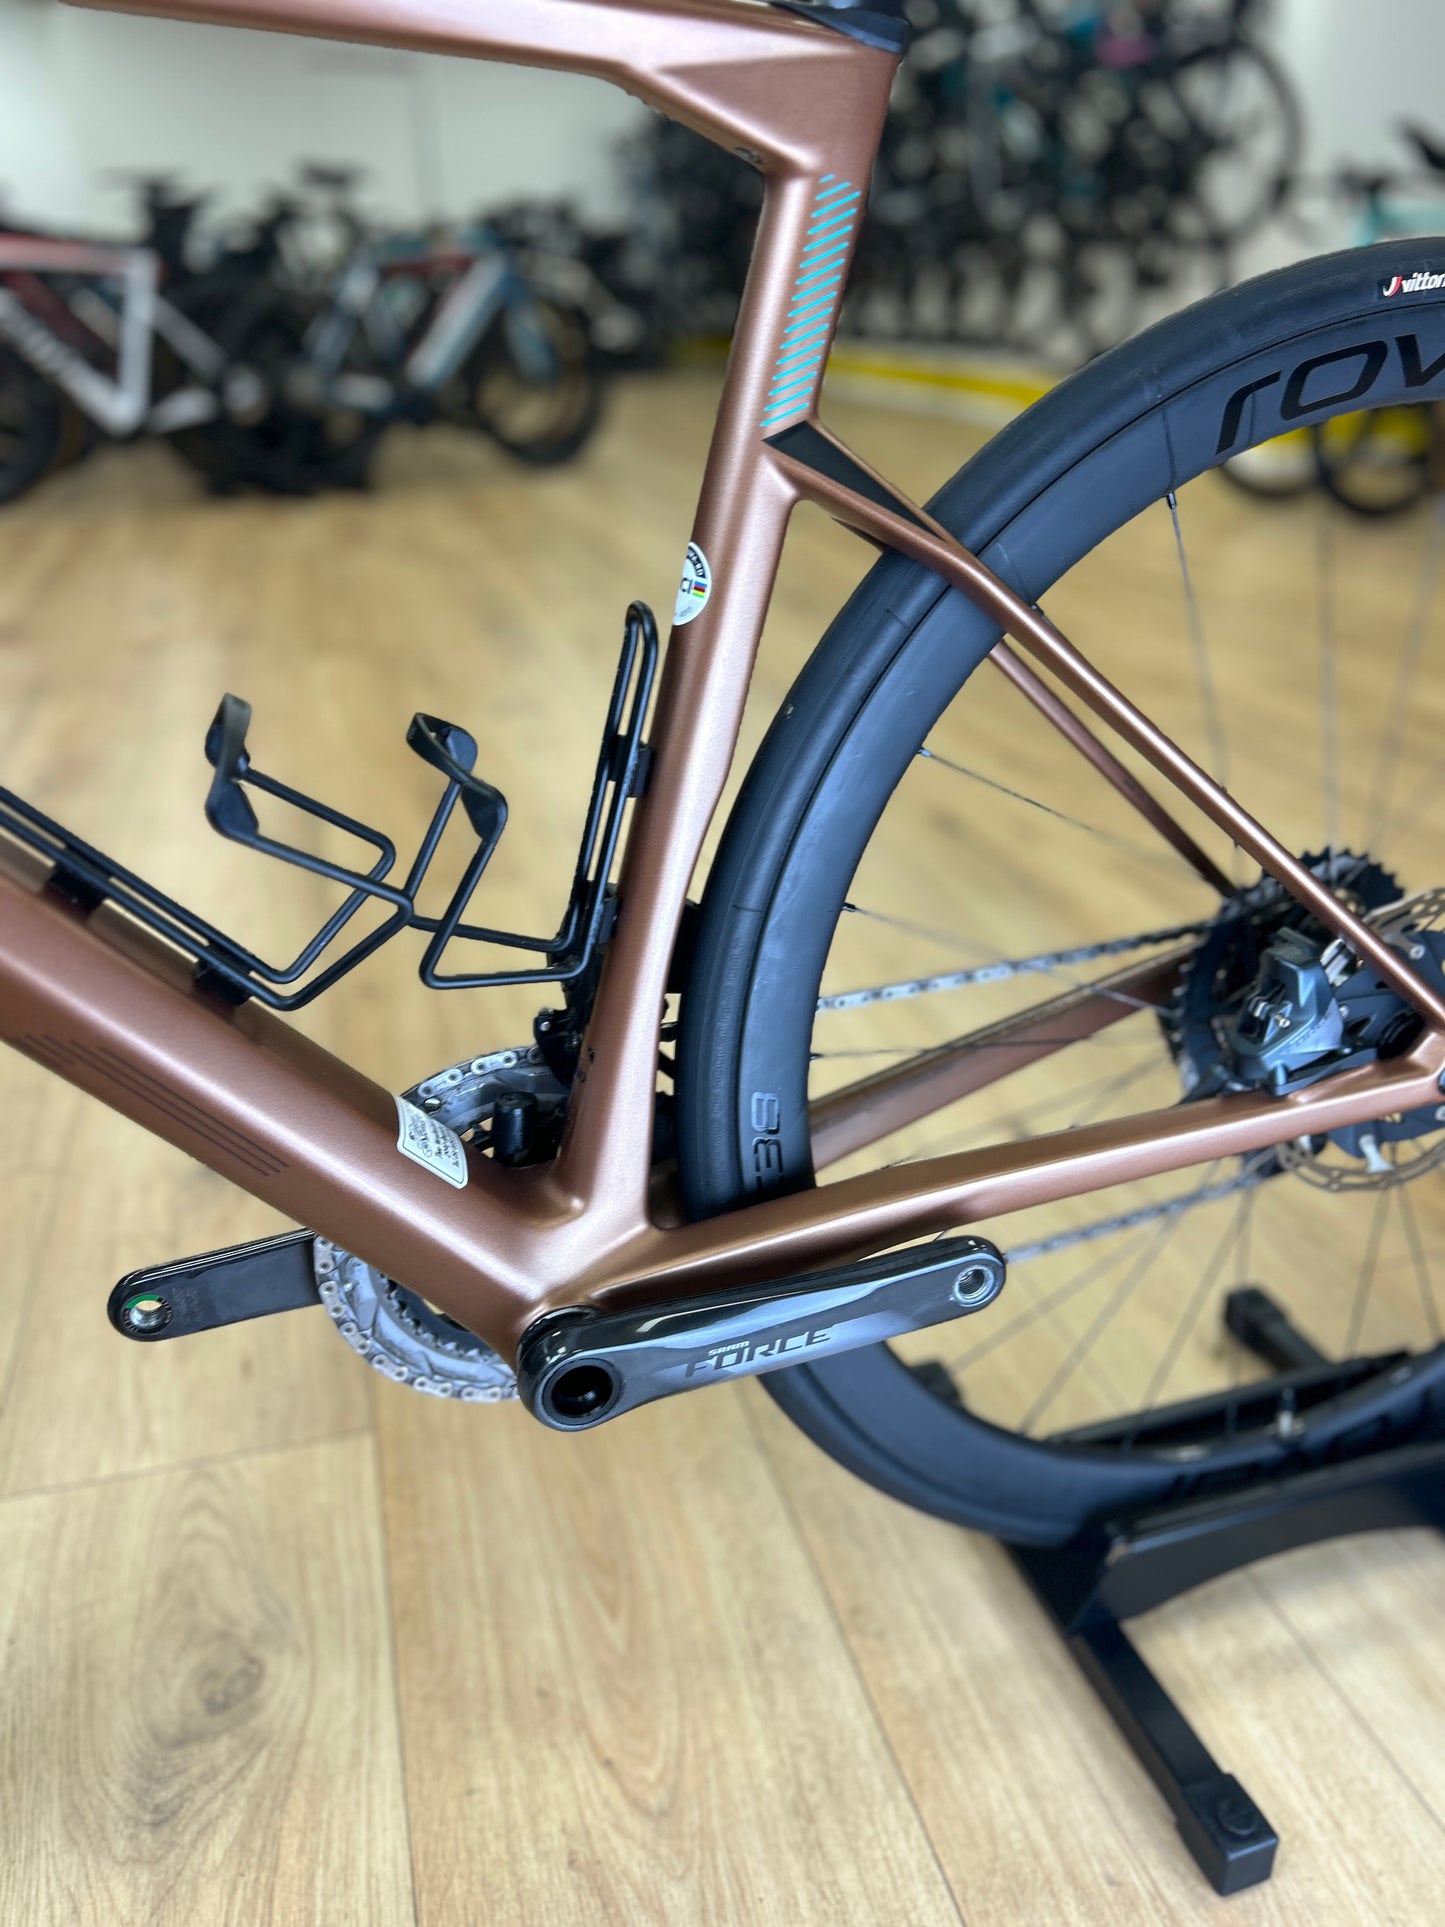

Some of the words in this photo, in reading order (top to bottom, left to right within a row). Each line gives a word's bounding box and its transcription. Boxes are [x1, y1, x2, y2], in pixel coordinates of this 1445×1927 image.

[1401, 271, 1445, 293] vittor
[751, 1092, 784, 1190] 38
[684, 1330, 831, 1378] FORCE
